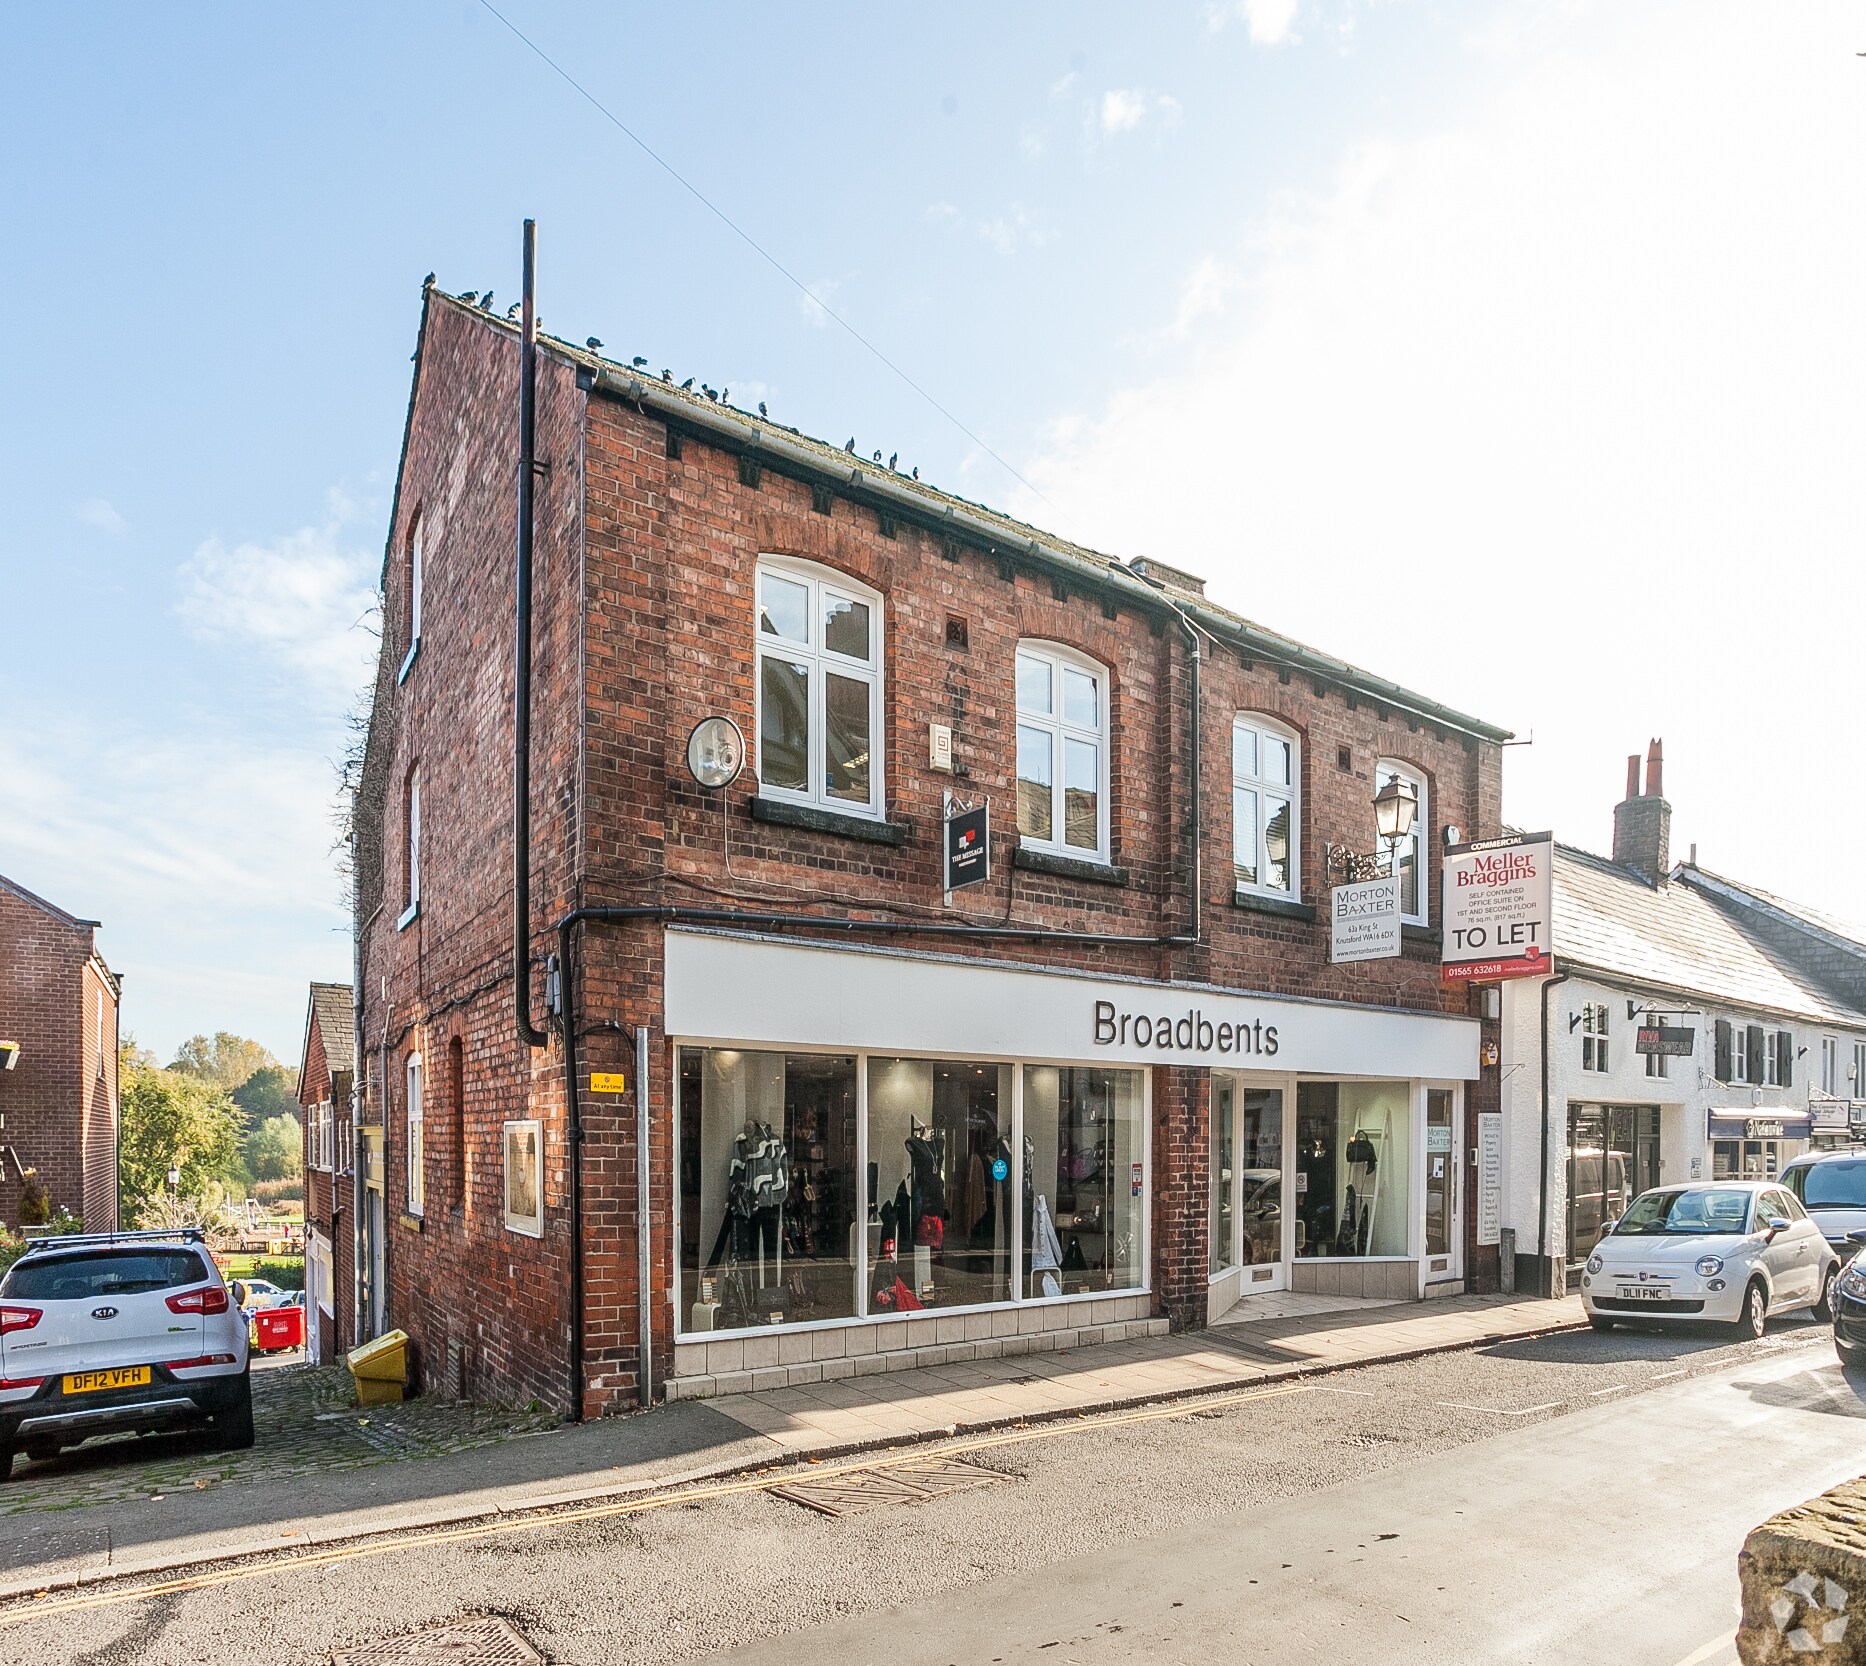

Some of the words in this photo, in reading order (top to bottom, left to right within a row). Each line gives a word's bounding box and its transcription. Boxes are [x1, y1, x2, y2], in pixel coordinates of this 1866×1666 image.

[1471, 837, 1523, 851] COMMERCIAL
[952, 854, 961, 863] THE
[962, 846, 984, 860] MESSAGE
[1474, 852, 1533, 873] Meller
[1457, 866, 1537, 888] Braggins
[1337, 886, 1394, 904] MORTON
[1486, 887, 1524, 897] CONTAINED
[1337, 899, 1394, 917] BAXTER
[1468, 899, 1492, 907] OFFICE
[1493, 897, 1512, 905] SUITE
[1485, 905, 1512, 914] SECOND
[1514, 902, 1537, 910] FLOOR
[1359, 924, 1371, 933] King
[1372, 922, 1378, 930] St
[1336, 935, 1361, 944] Knutsford
[1363, 932, 1380, 941] WA16
[1381, 930, 1394, 939] 6DX
[1452, 927, 1487, 949] TO
[1497, 921, 1541, 945] LET
[1448, 966, 1472, 976] 01565
[1474, 964, 1502, 974] 632618
[1094, 1000, 1279, 1056] Broadbents
[1622, 1288, 1640, 1298] DL11
[1643, 1289, 1662, 1299] FNC
[95, 1308, 115, 1317] KIA
[73, 1373, 108, 1390] DF12
[112, 1369, 142, 1385] VFH
